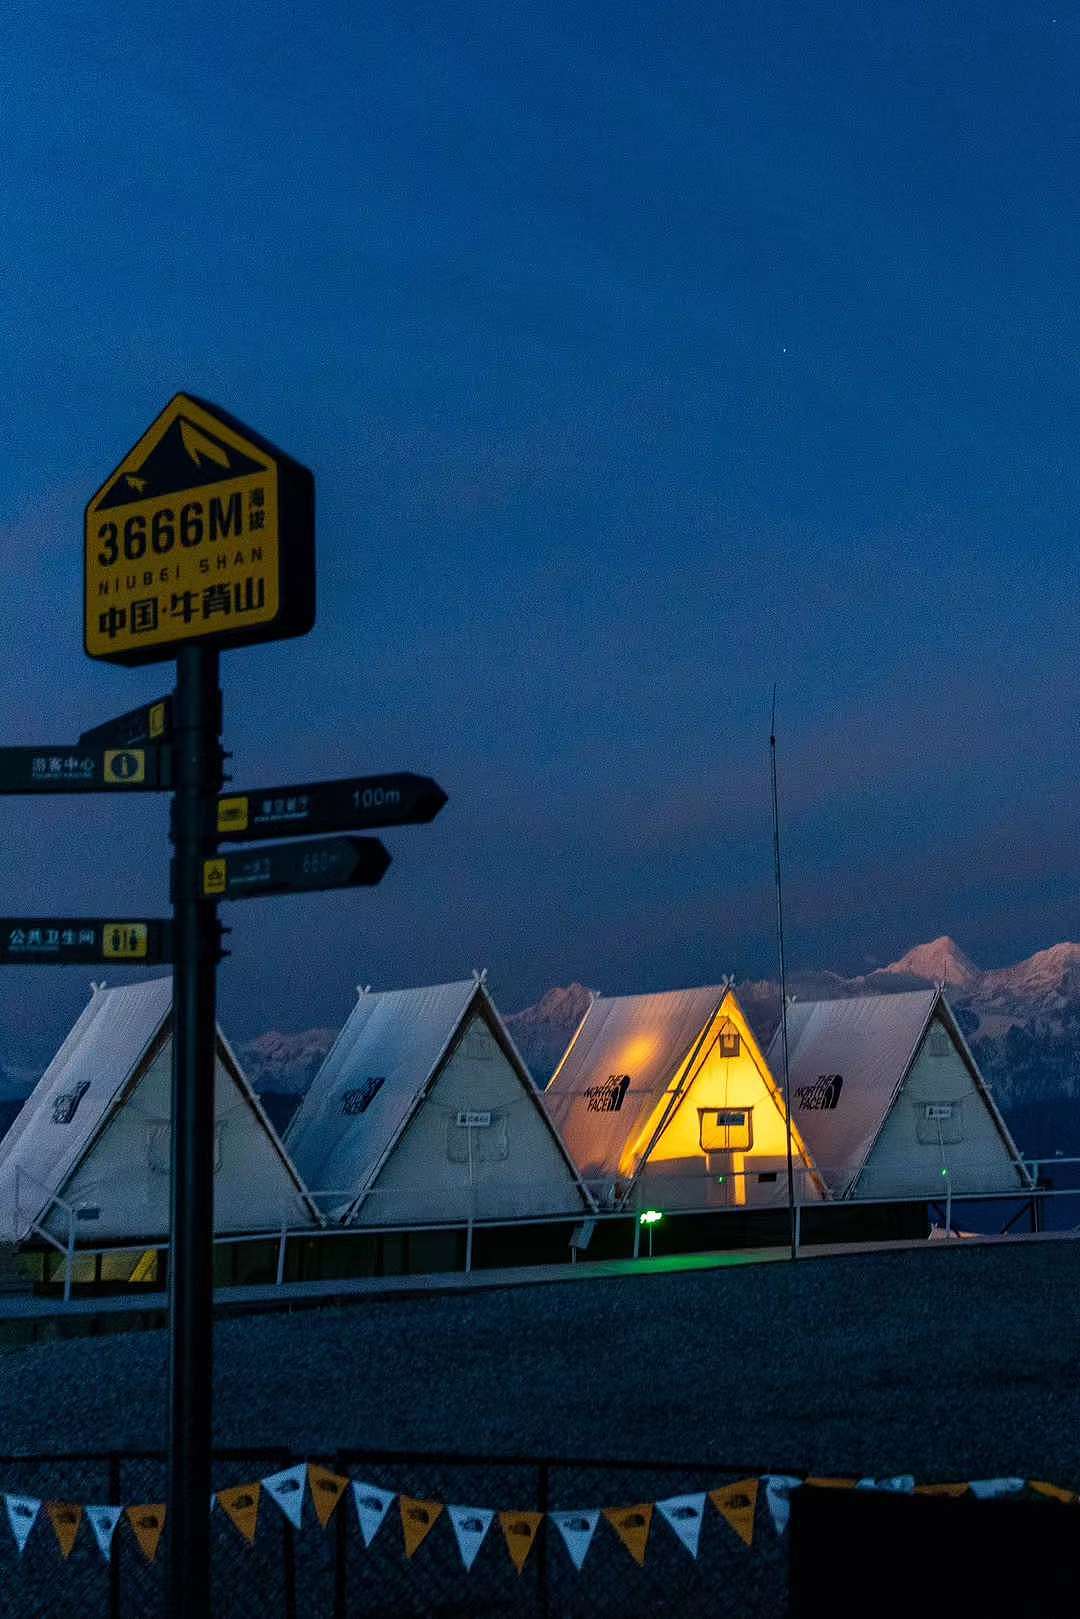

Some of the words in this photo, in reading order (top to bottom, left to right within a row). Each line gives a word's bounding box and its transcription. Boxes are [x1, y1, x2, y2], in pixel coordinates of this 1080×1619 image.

[98, 493, 242, 567] 3666M
[98, 565, 182, 596] NIUBEI
[199, 548, 263, 574] SHAN
[352, 788, 400, 804] 100m
